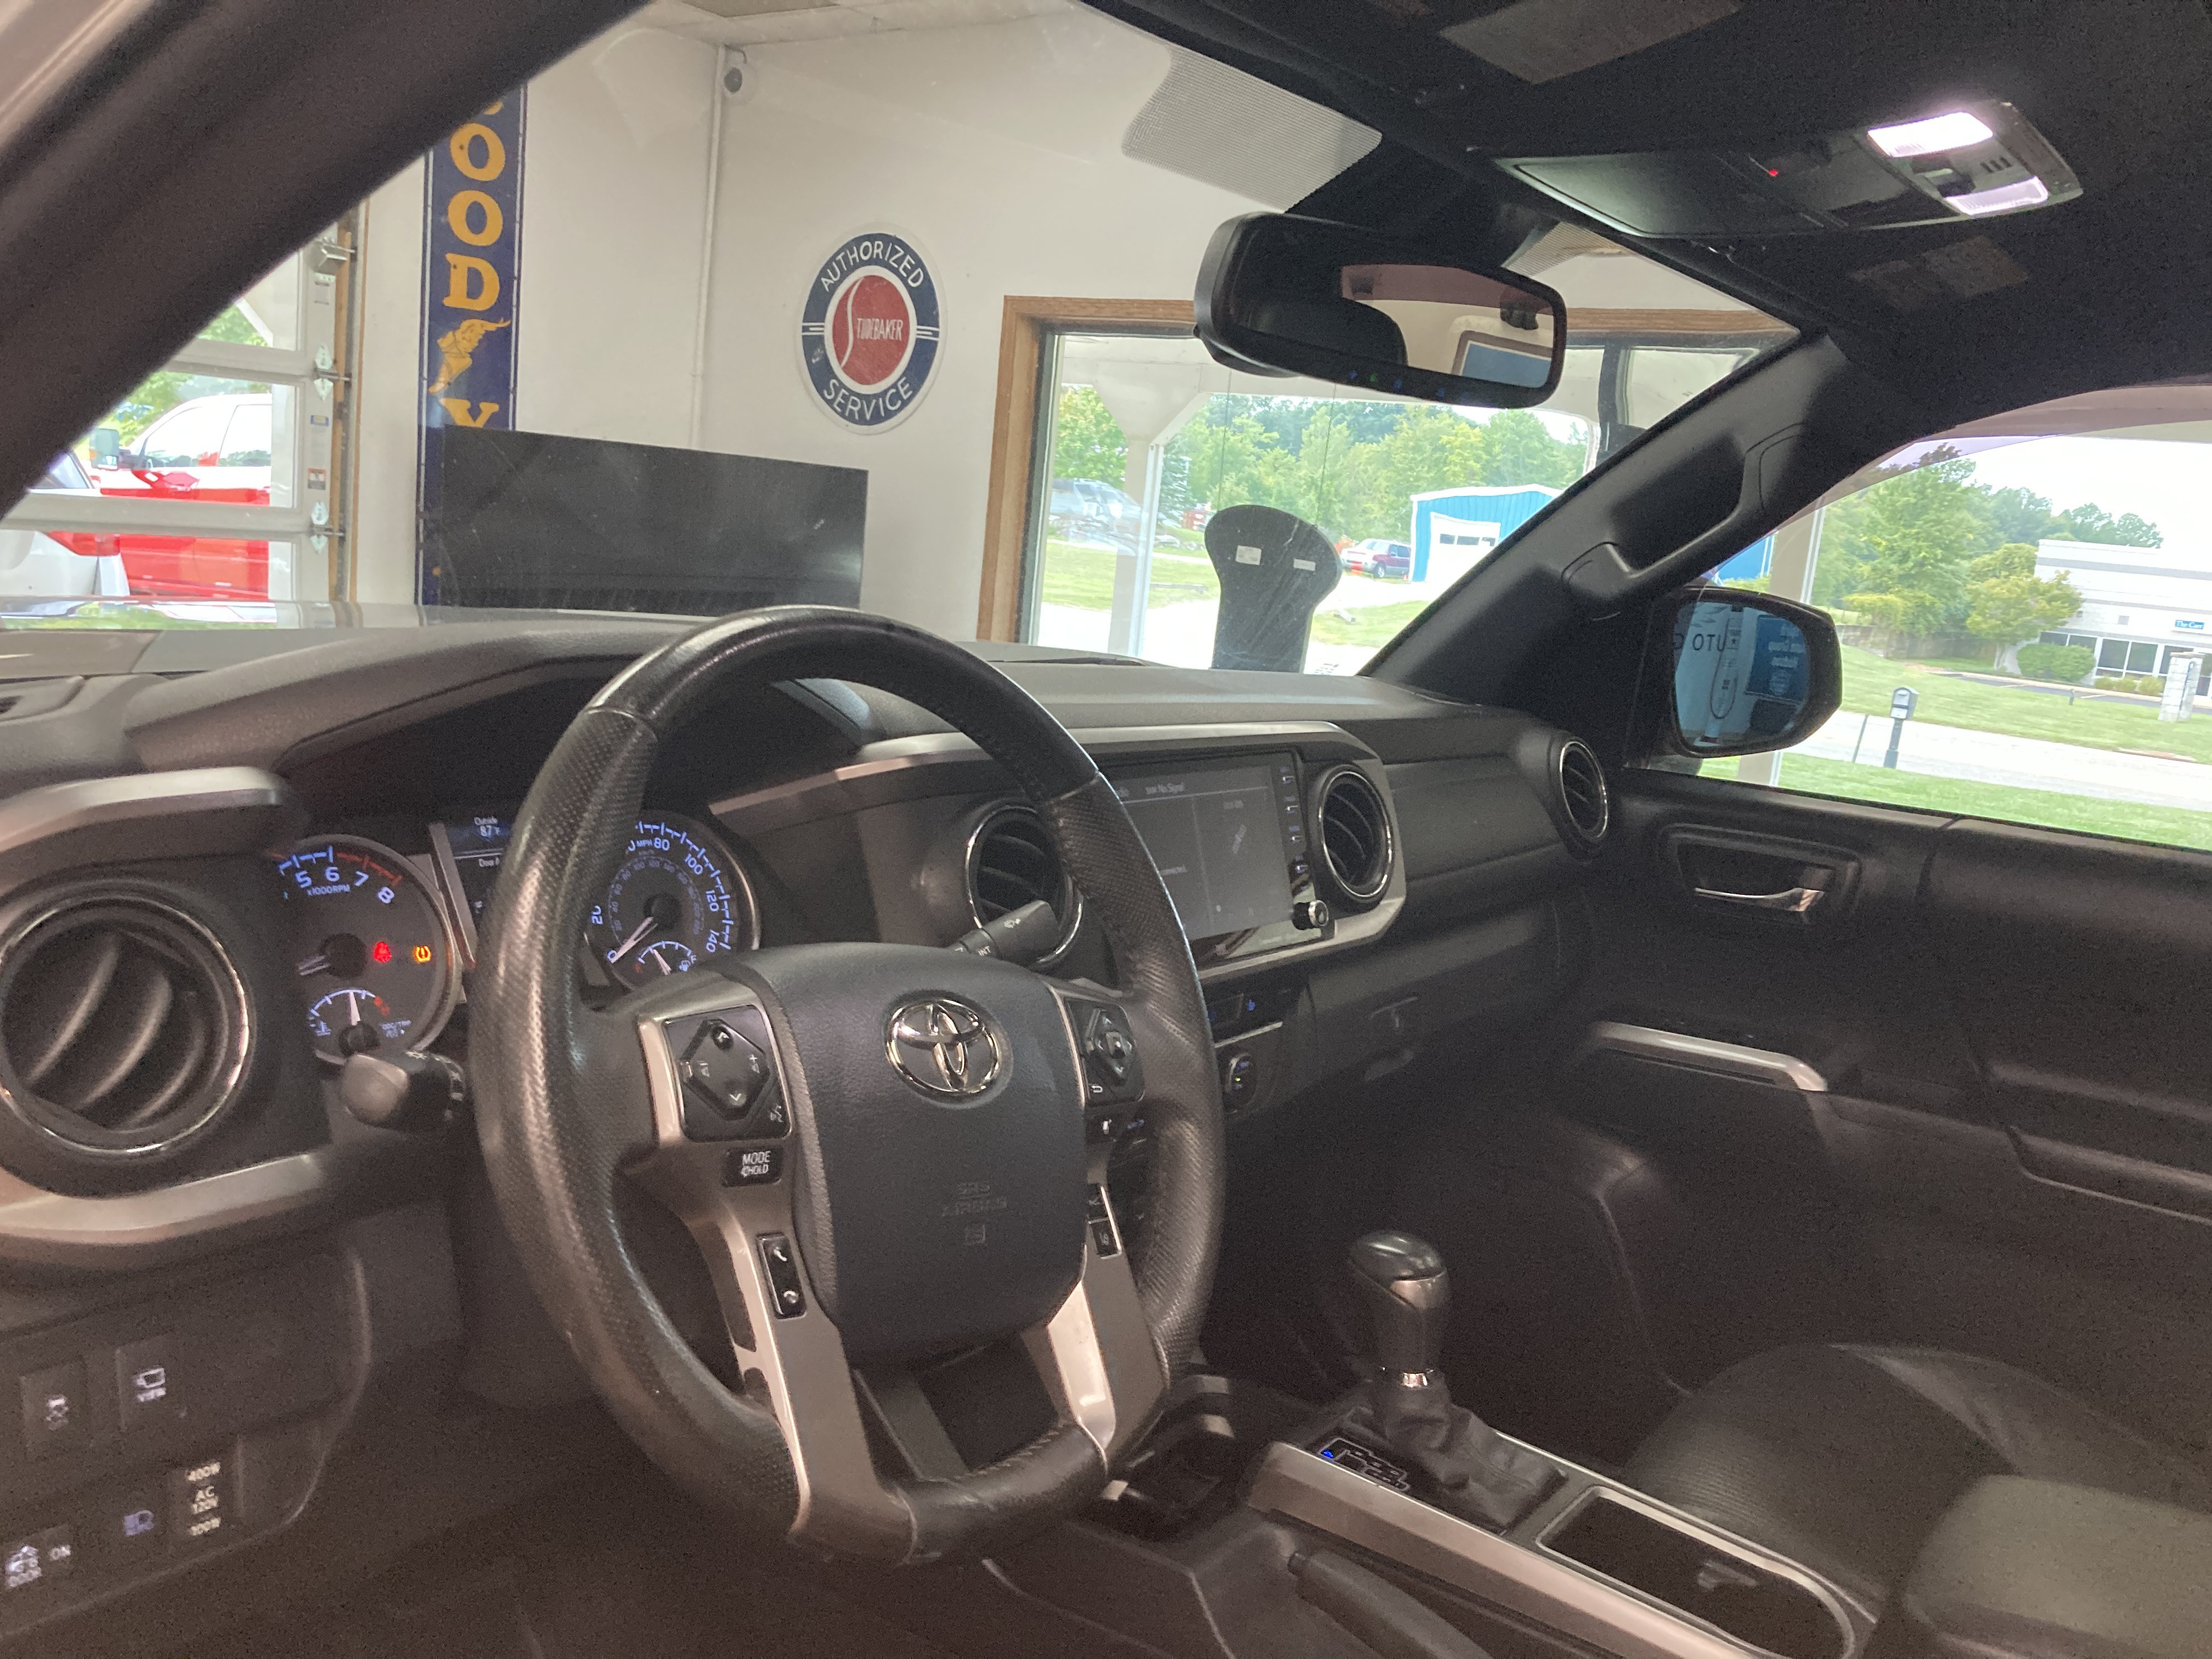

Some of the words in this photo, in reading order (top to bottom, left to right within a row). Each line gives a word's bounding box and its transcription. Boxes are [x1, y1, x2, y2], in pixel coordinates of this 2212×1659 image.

[442, 101, 506, 311] OOD
[820, 240, 924, 292] AUTHORIZED
[823, 376, 913, 421] SERVICE
[653, 837, 670, 851] 80
[684, 853, 703, 875] 100
[295, 870, 312, 888] 5
[325, 866, 340, 882] 6
[354, 871, 369, 887] 7
[377, 886, 395, 904] 8
[705, 889, 720, 912] 120
[706, 929, 720, 953] 140
[978, 945, 991, 956] INT
[742, 1150, 771, 1165] MODE
[194, 1485, 215, 1502] AC
